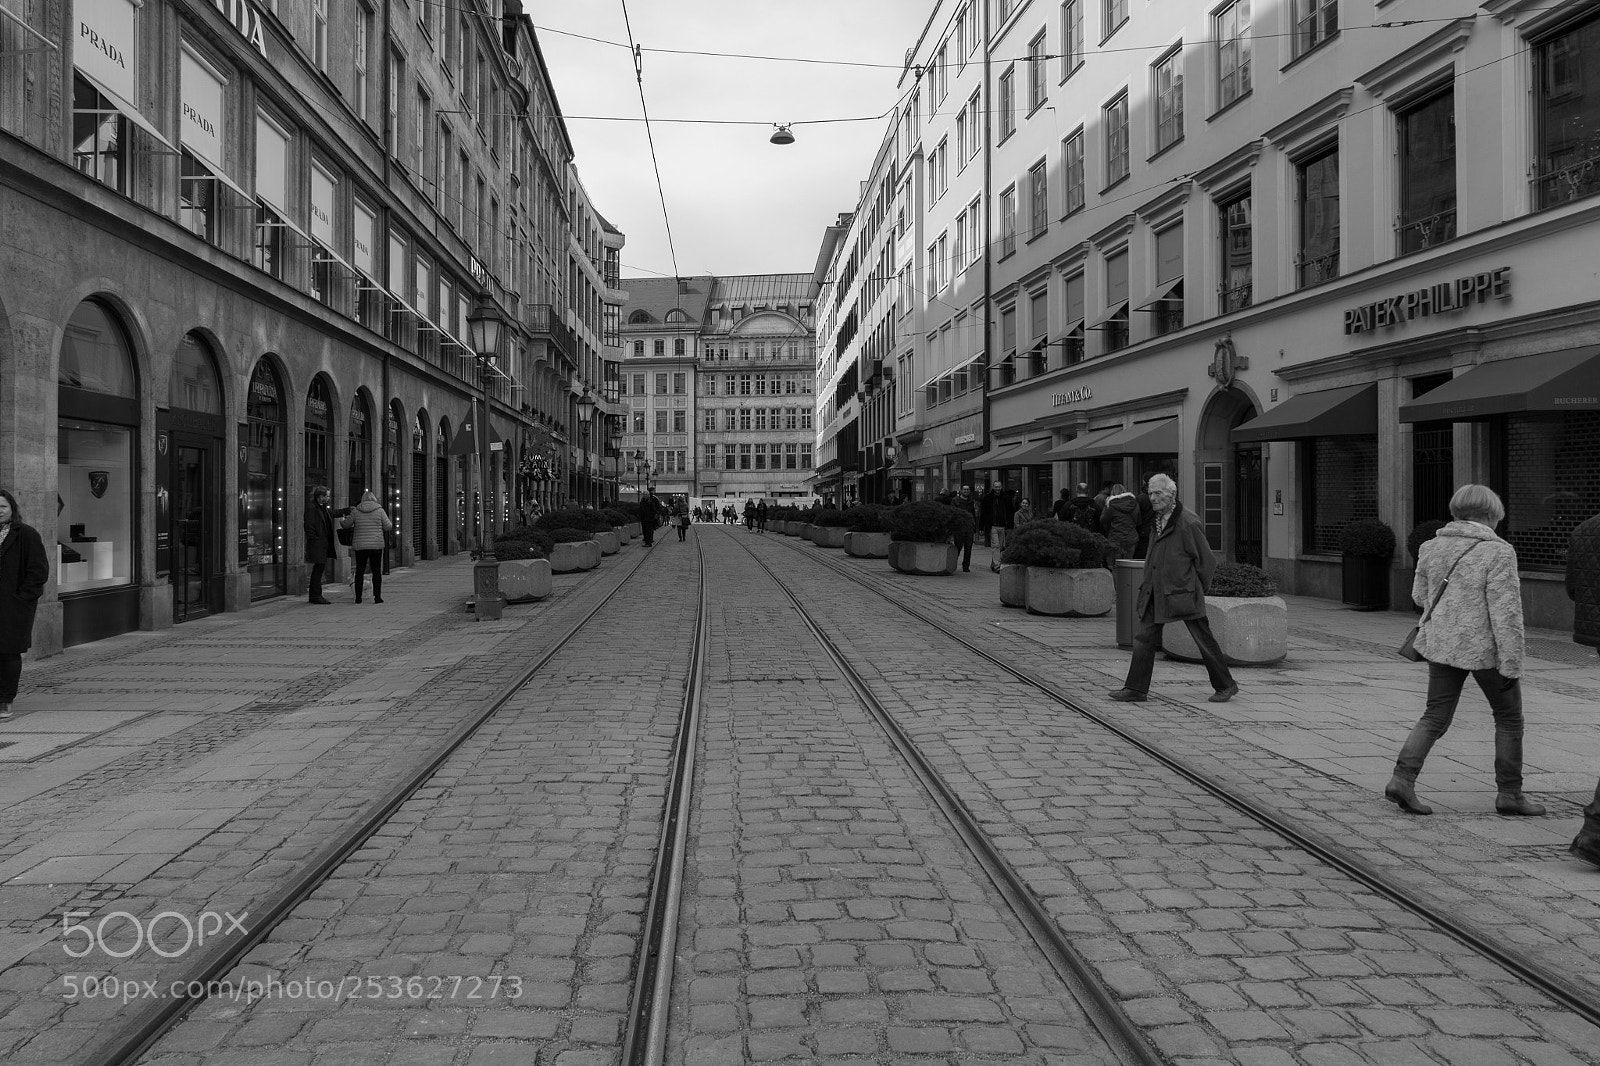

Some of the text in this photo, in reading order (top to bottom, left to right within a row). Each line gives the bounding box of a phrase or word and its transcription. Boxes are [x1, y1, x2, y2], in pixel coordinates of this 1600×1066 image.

[80, 22, 125, 69] PRADA
[183, 103, 215, 138] PRADA
[1343, 267, 1512, 335] PATEK PHILIPPE
[1554, 397, 1598, 405] BUCHERER
